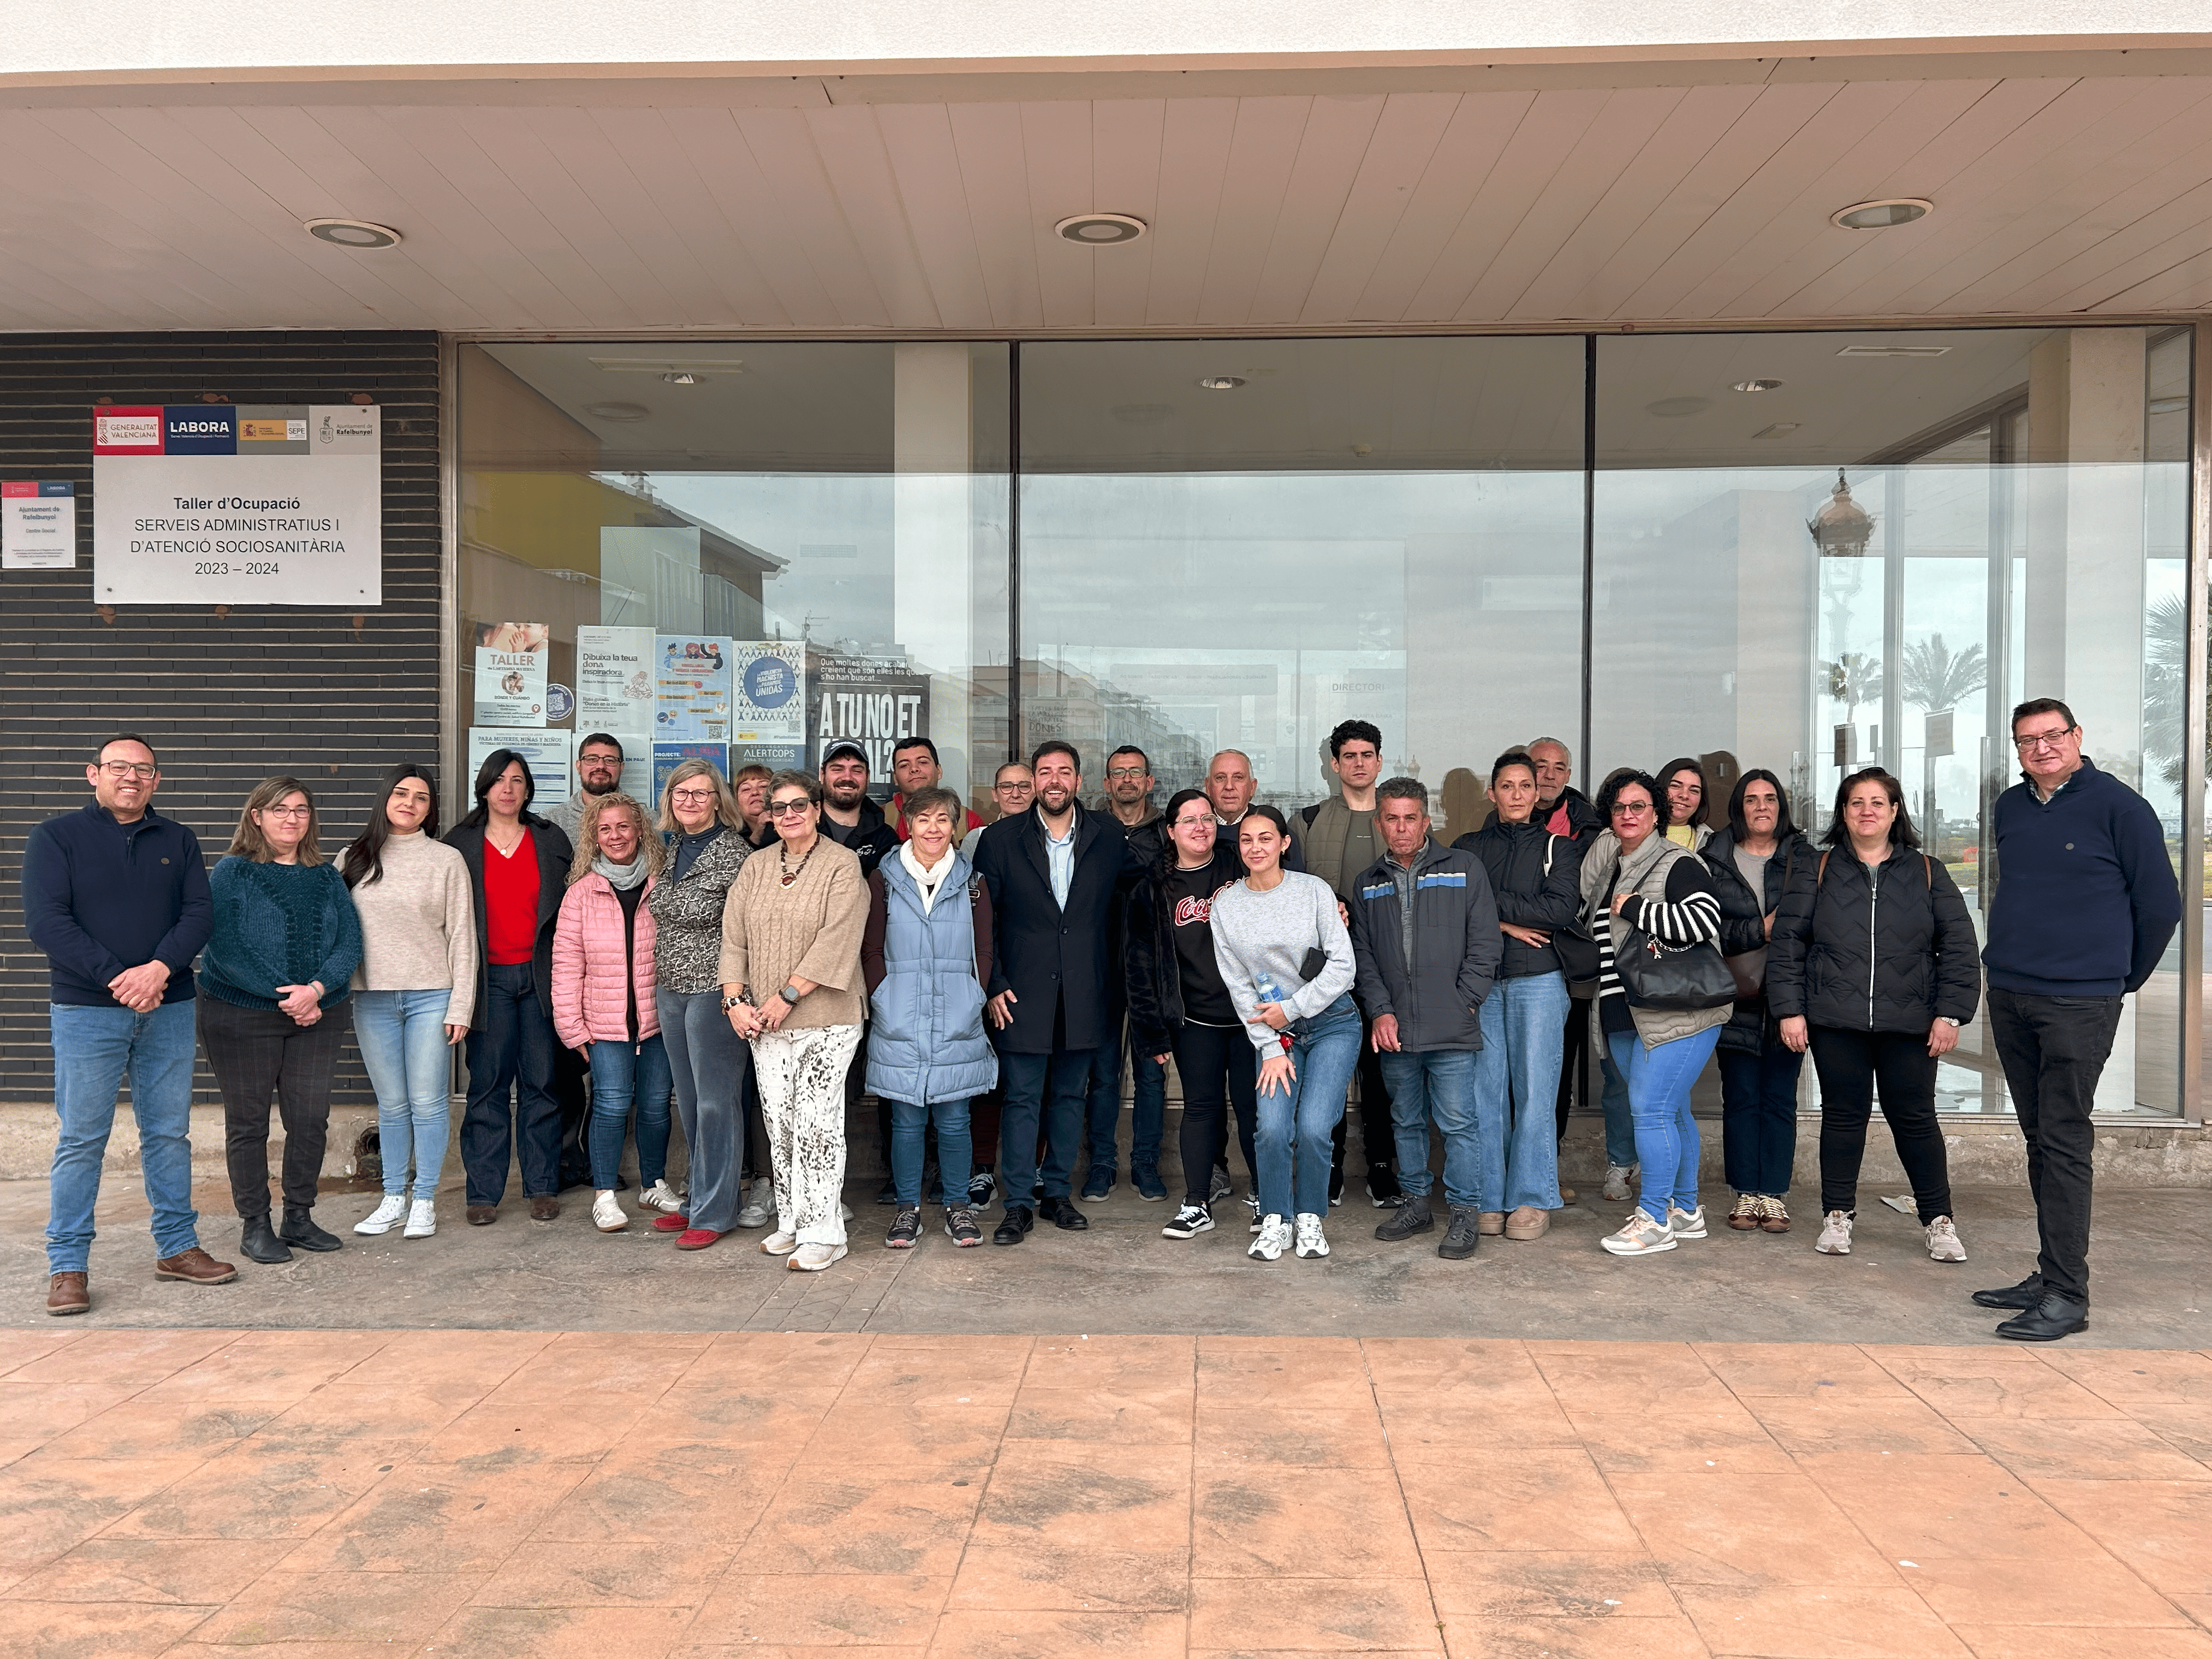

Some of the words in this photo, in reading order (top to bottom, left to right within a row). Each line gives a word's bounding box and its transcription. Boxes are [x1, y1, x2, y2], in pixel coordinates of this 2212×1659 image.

[170, 421, 230, 433] LABORA
[174, 497, 213, 509] Taller
[217, 496, 301, 512] d'Ocupació
[135, 519, 200, 531] SERVEIS
[203, 519, 331, 531] ADMINISTRATIUS
[336, 519, 340, 531] I
[130, 538, 211, 553] D'ATENCIÓ
[215, 538, 346, 553] SOCIOSANITÀRIA
[195, 563, 228, 575] 2023
[245, 563, 280, 575] 2024
[490, 654, 536, 666] TALLER
[820, 658, 834, 667] Que
[862, 666, 875, 674] són
[756, 673, 784, 683] MACHISTA
[756, 683, 783, 697] UNIDAS
[1331, 683, 1385, 692] DIRECTORI
[819, 692, 834, 737] A
[836, 693, 863, 738] TU
[865, 694, 894, 739] NO
[897, 695, 921, 739] ET
[1028, 721, 1062, 733] DONES
[743, 748, 795, 758] ALERTCOPS
